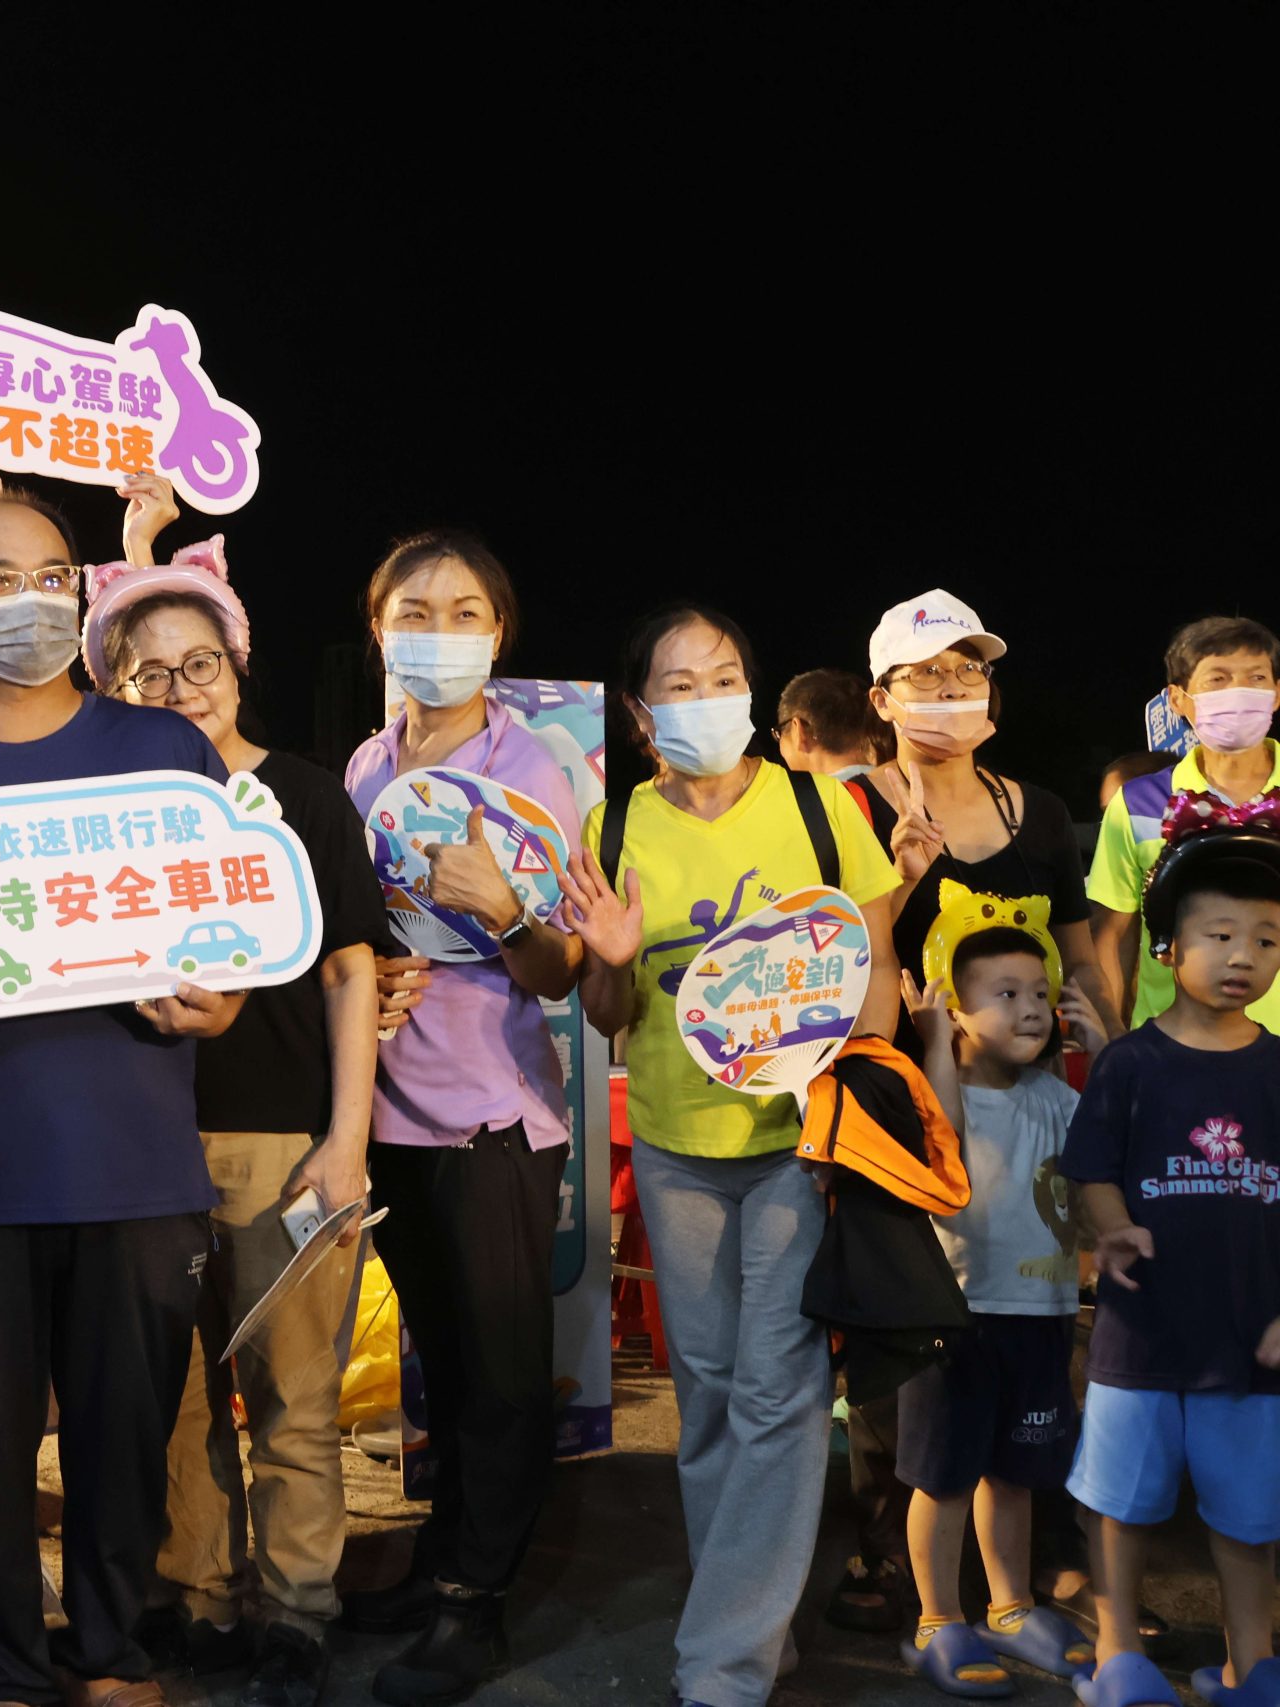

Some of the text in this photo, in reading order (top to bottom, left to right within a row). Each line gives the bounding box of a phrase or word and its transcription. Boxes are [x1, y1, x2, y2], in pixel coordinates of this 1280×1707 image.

[1166, 1155, 1280, 1180] Fine Girls
[1140, 1178, 1239, 1199] Summer
